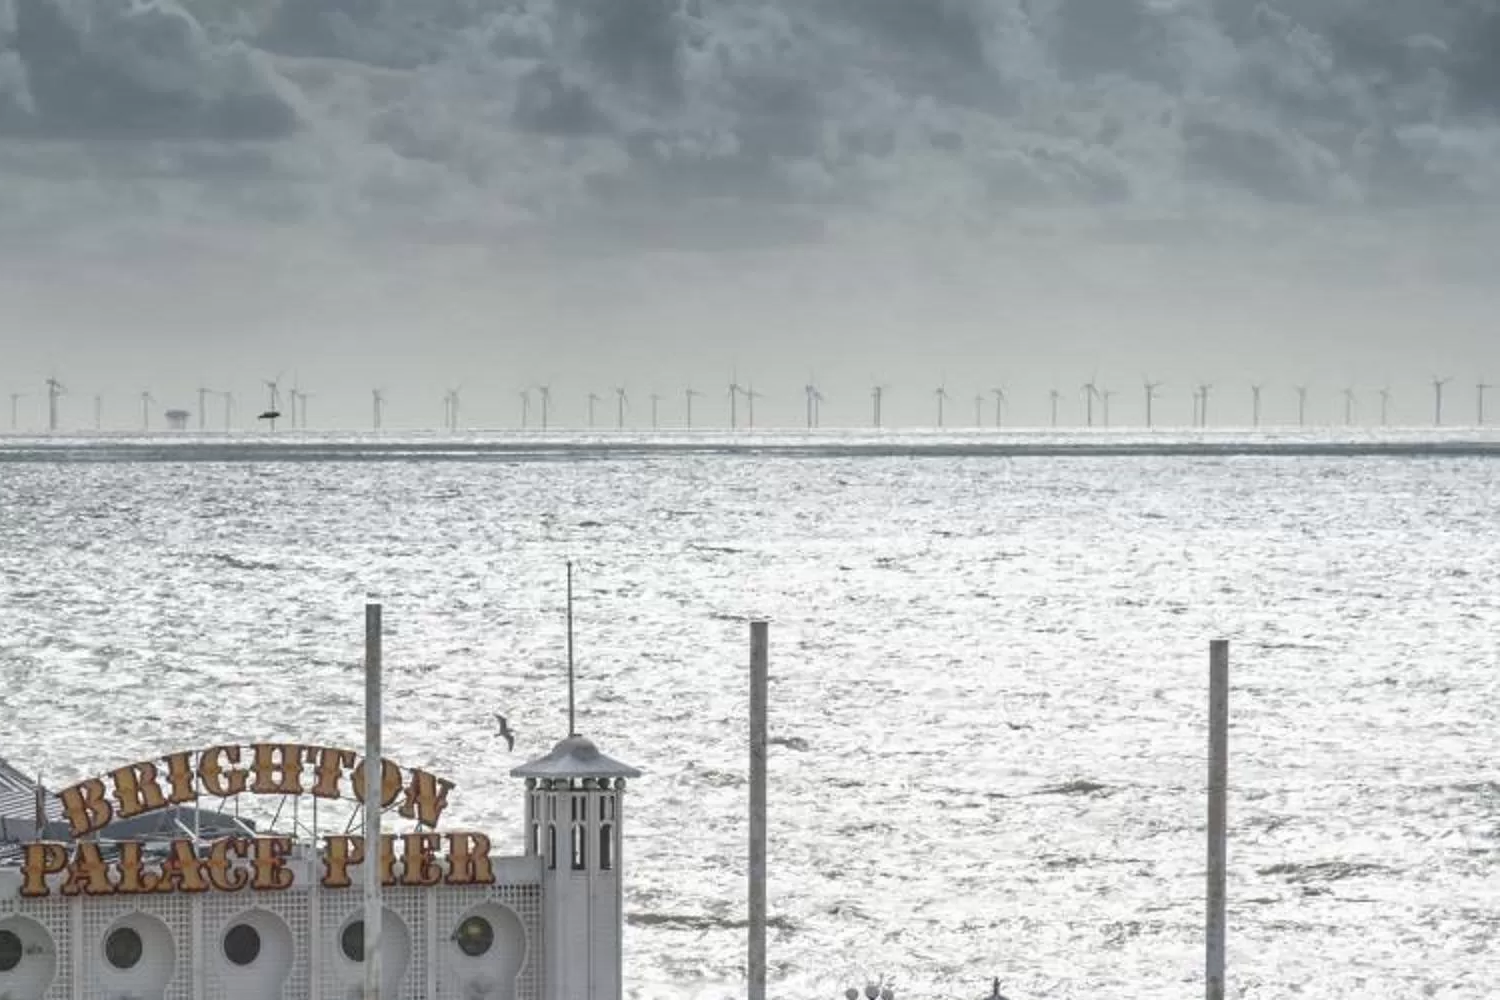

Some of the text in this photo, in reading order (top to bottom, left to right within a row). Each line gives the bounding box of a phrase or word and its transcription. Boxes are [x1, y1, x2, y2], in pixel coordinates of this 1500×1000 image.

[56, 742, 456, 839] BRIGHTON
[19, 832, 496, 897] PALACE PIER
